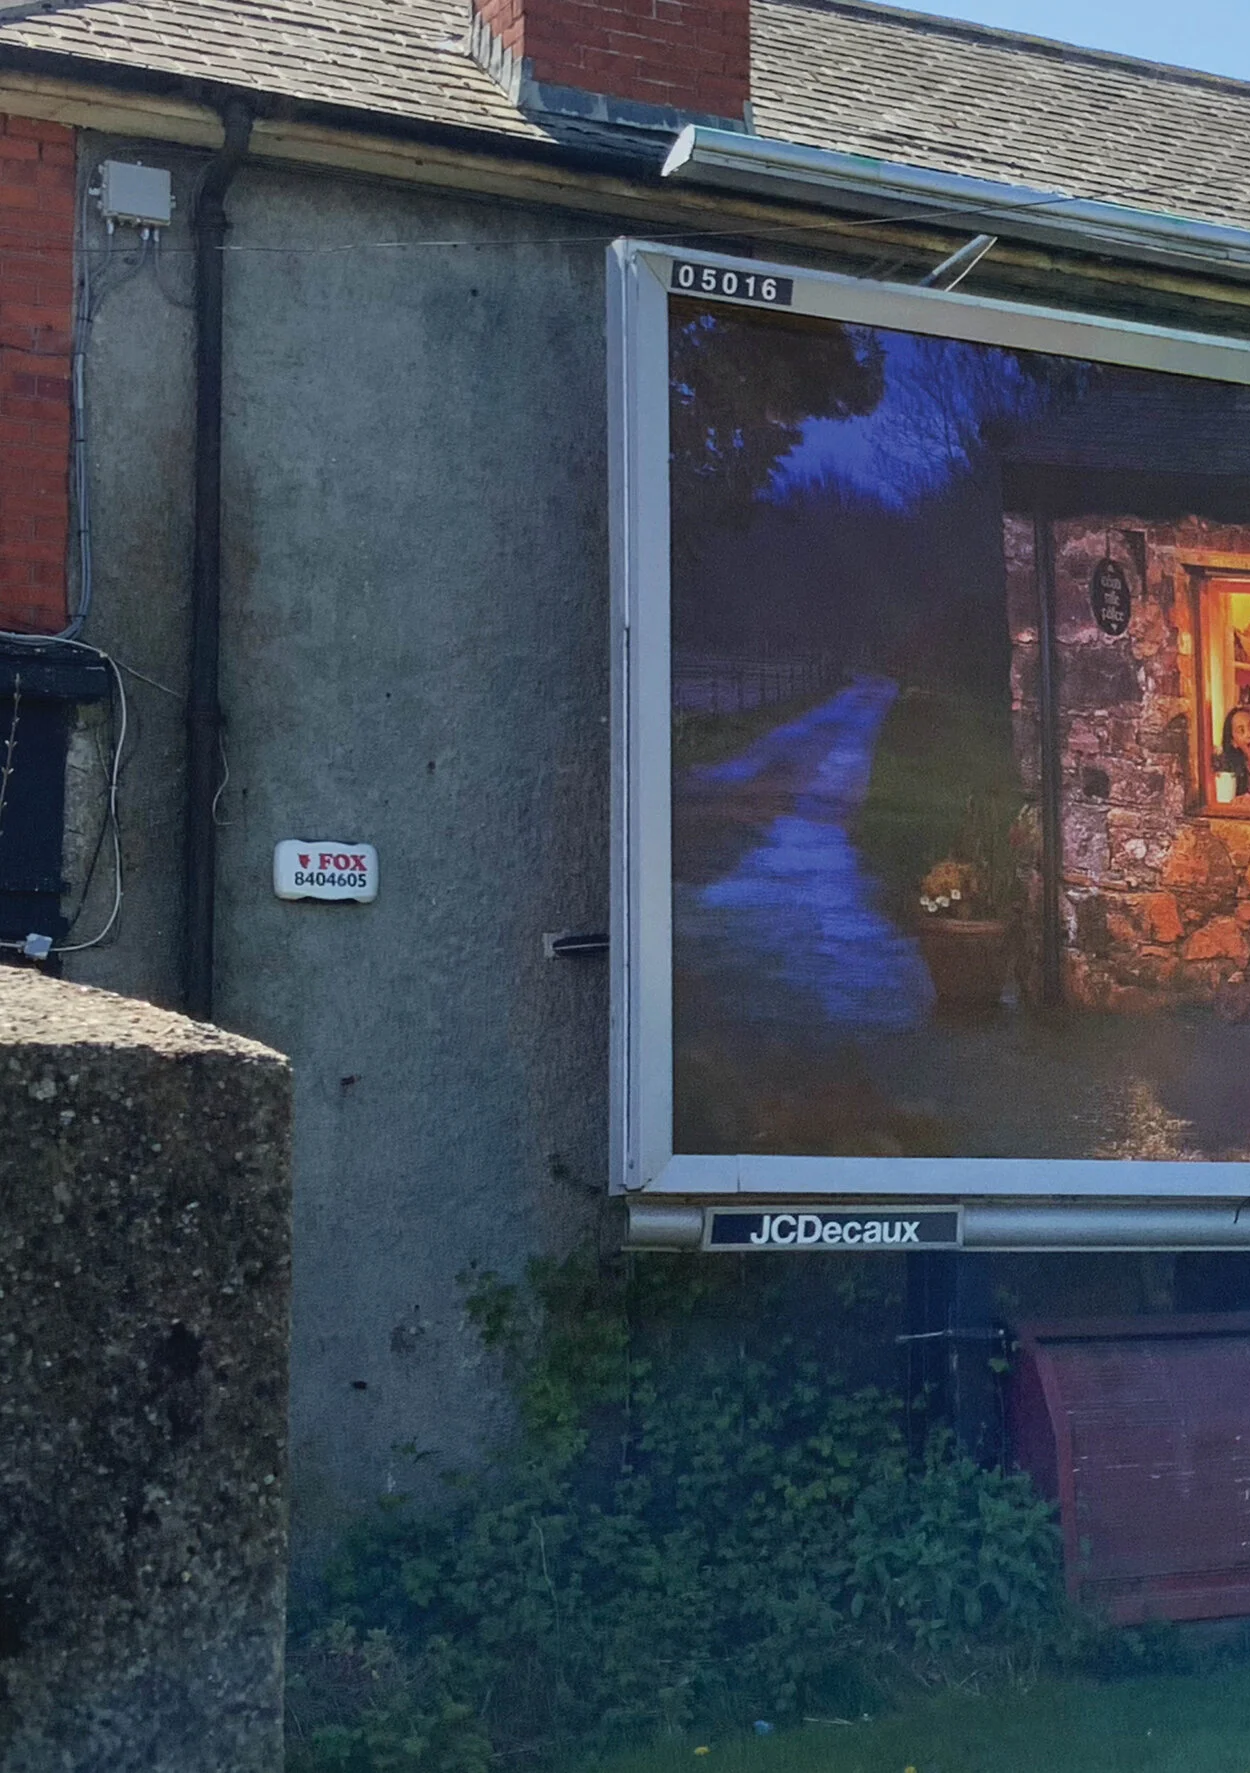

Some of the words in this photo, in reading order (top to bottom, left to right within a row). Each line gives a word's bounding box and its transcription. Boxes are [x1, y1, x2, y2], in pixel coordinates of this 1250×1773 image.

[679, 265, 777, 300] 05016
[318, 853, 367, 871] FOX
[294, 871, 367, 887] 8404605
[750, 1214, 921, 1245] JCDecaux
